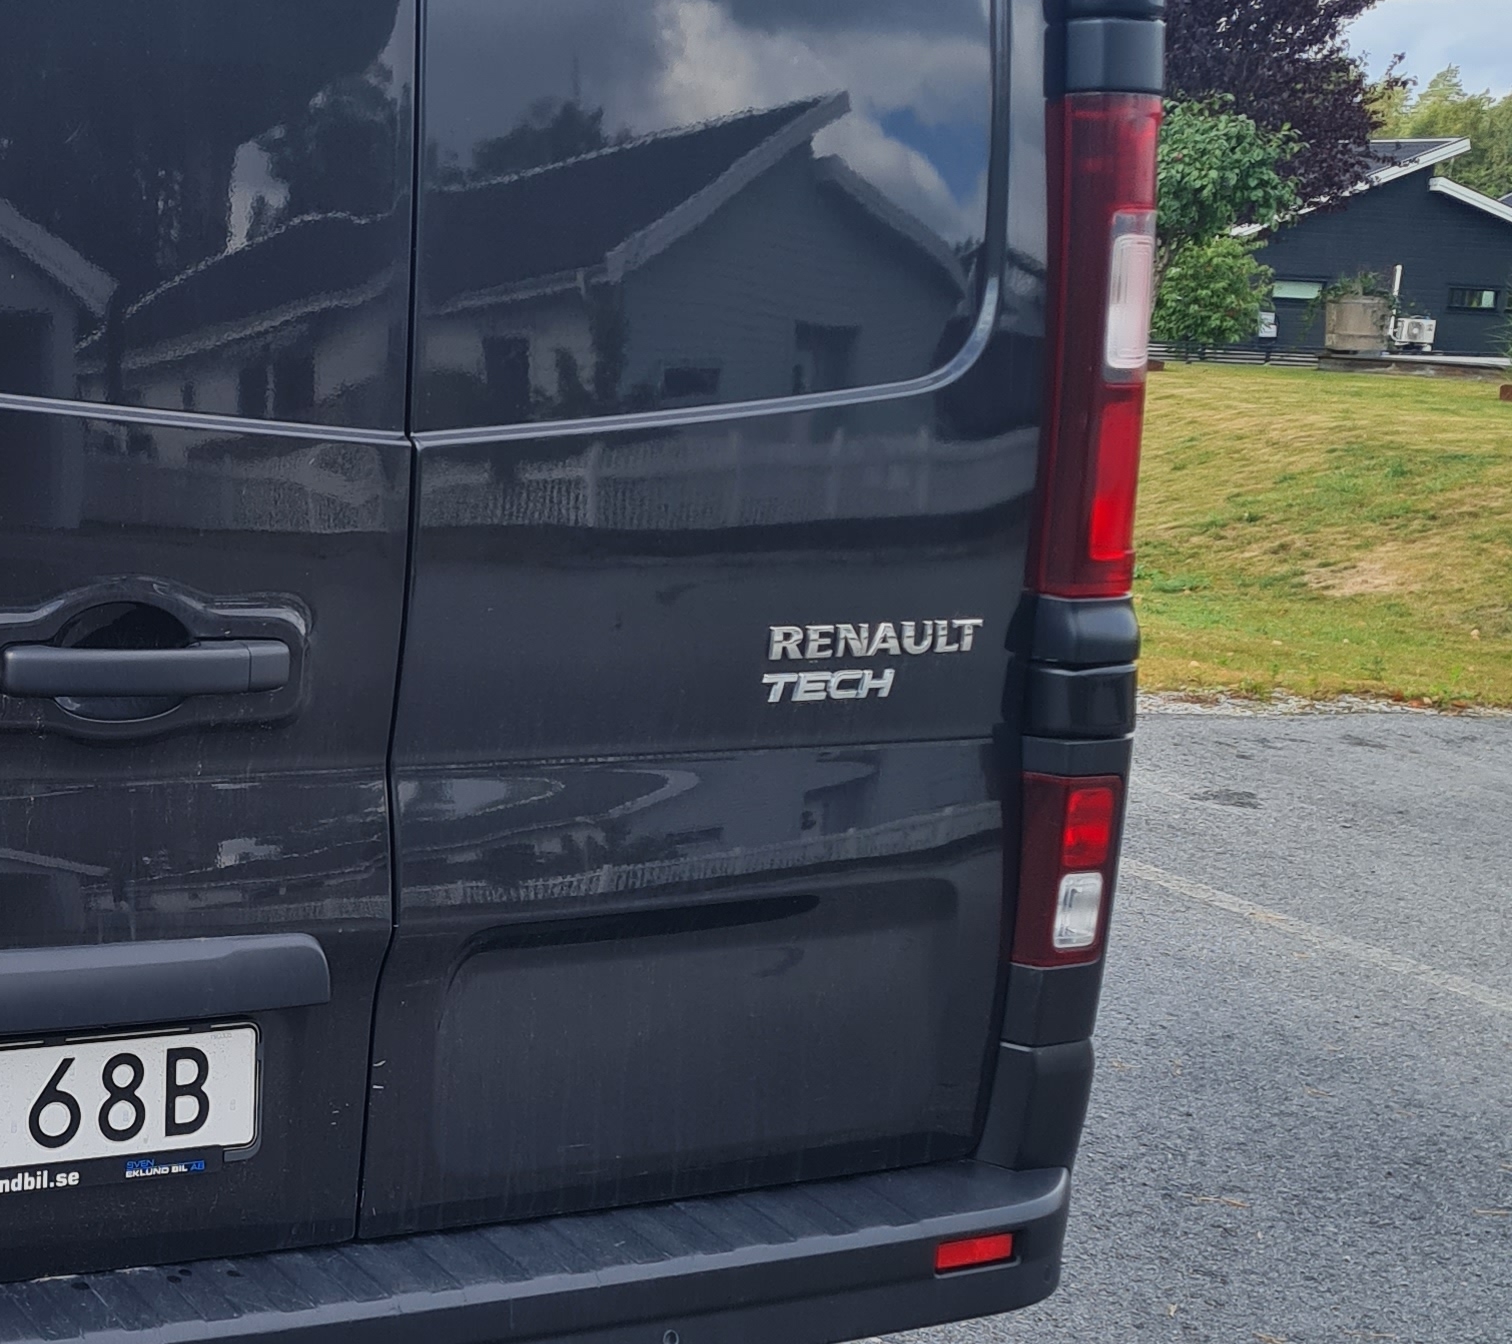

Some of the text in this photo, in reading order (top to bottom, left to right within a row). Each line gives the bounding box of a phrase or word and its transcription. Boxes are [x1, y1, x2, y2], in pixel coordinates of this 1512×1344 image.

[769, 619, 984, 660] RENAULT
[761, 668, 896, 703] TECH
[27, 1046, 210, 1150] 68B
[125, 1165, 171, 1179] EKLUND
